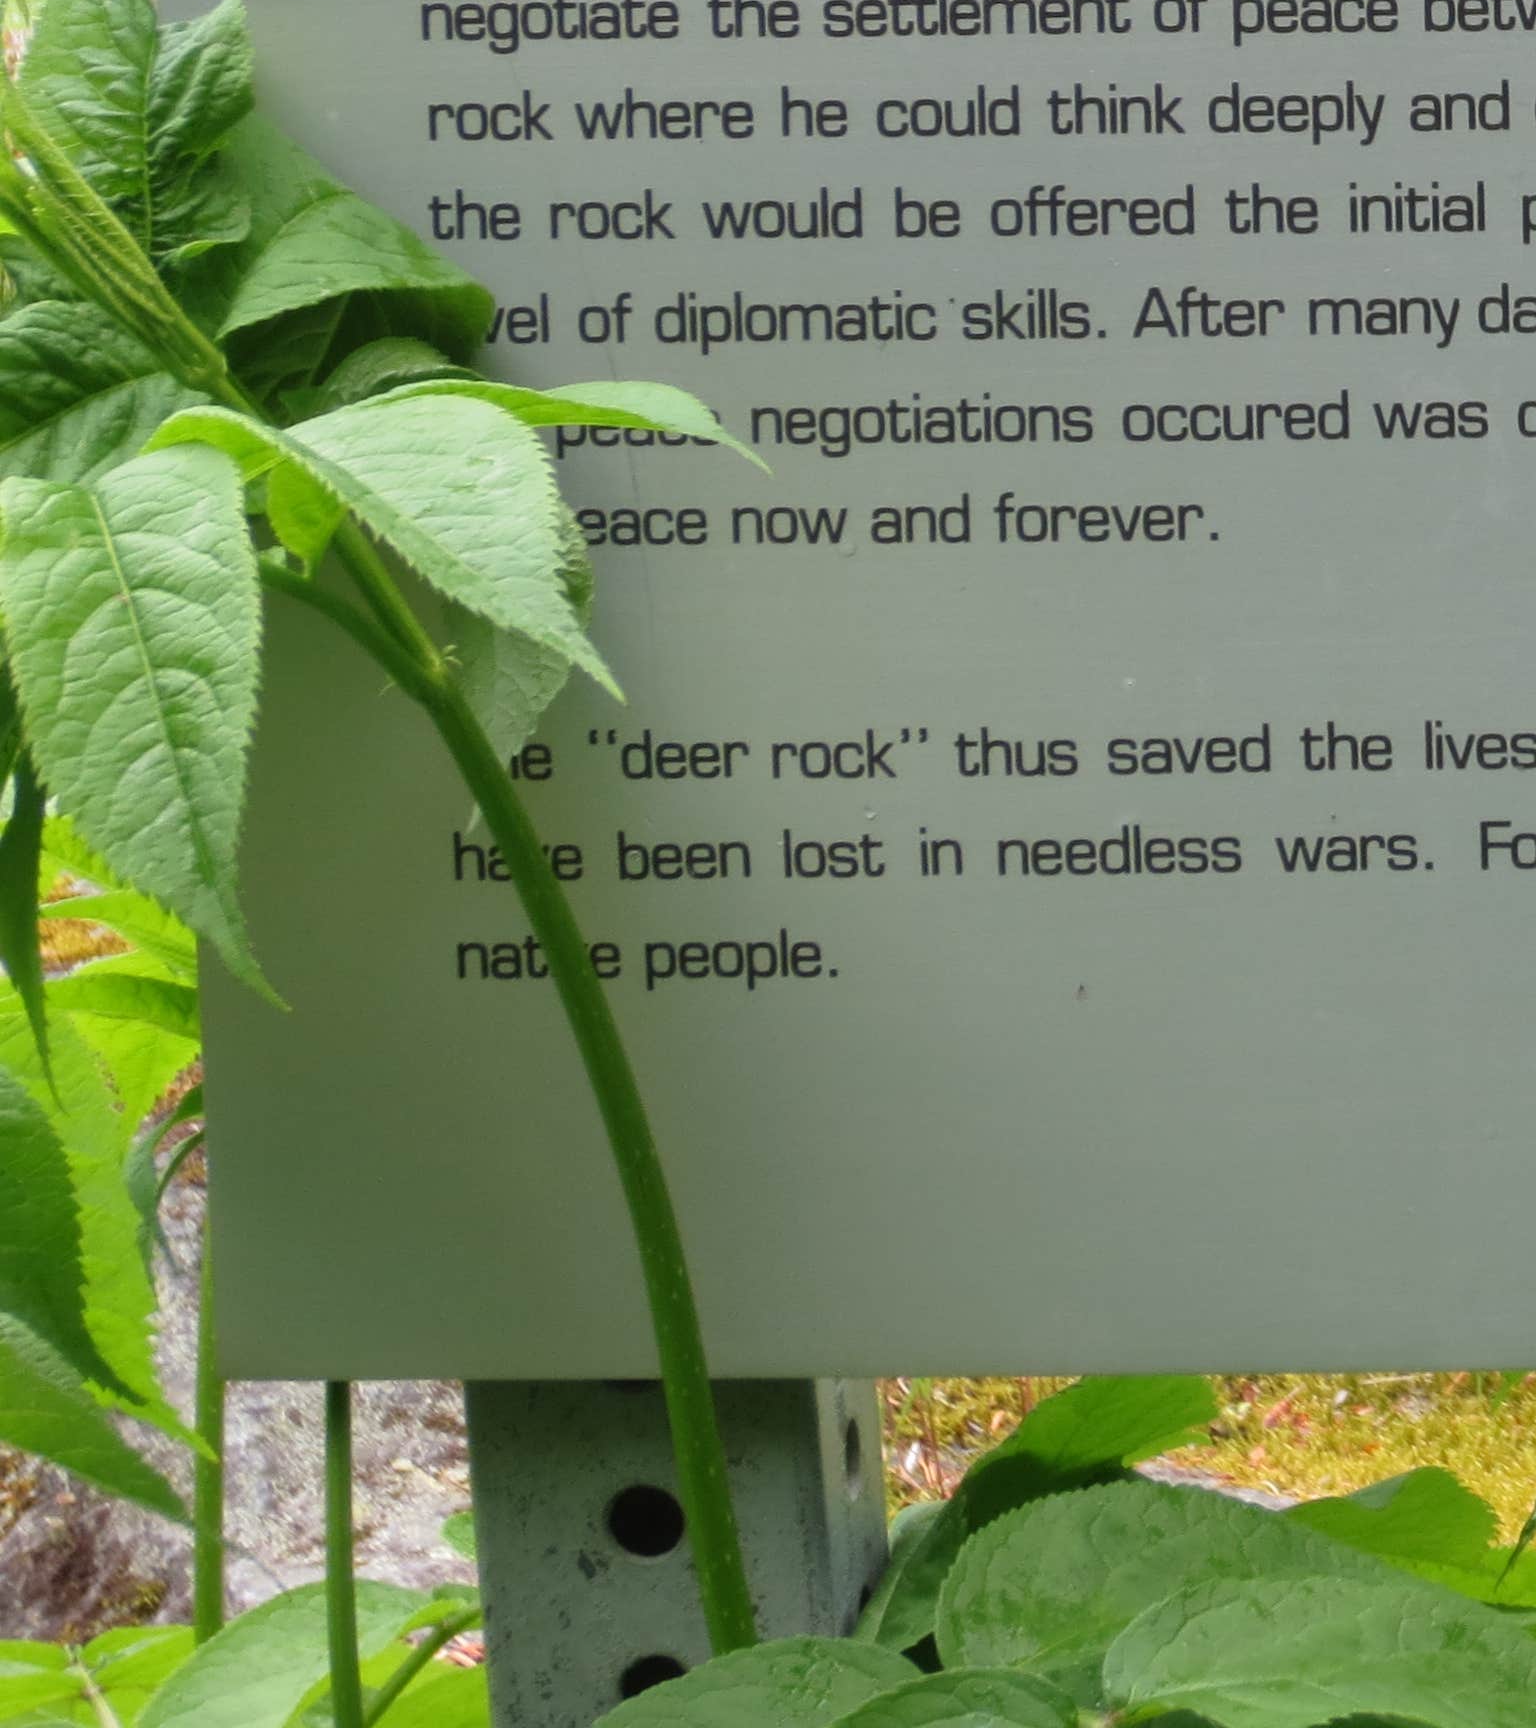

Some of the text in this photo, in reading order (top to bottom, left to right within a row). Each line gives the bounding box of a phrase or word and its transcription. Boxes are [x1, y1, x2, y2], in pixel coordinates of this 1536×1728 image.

[427, 89, 555, 142] rock
[574, 87, 755, 140] where
[780, 85, 849, 138] he
[876, 84, 1021, 139] could
[1046, 82, 1186, 136] think
[1207, 79, 1386, 147] deeply
[1409, 78, 1511, 133] and
[577, 291, 633, 344] of
[654, 289, 938, 356] diplomatic
[961, 287, 1107, 341] skills.
[1132, 285, 1286, 339] After
[1308, 296, 1461, 350] many
[750, 391, 1094, 459] negotiations
[1122, 388, 1350, 443] occured
[1372, 401, 1489, 440] was
[576, 491, 1220, 548] eace now and forever.
[587, 728, 750, 780] “deer
[771, 727, 929, 780] rock”
[953, 726, 1079, 778] thus
[1107, 722, 1272, 776] saved
[1299, 720, 1393, 772] the
[453, 831, 583, 881] hae
[616, 829, 752, 881] been
[782, 828, 886, 879] lost
[919, 826, 964, 877] in
[997, 823, 1243, 877] needless
[1274, 834, 1434, 873] wars.
[456, 926, 841, 993] nate people.
